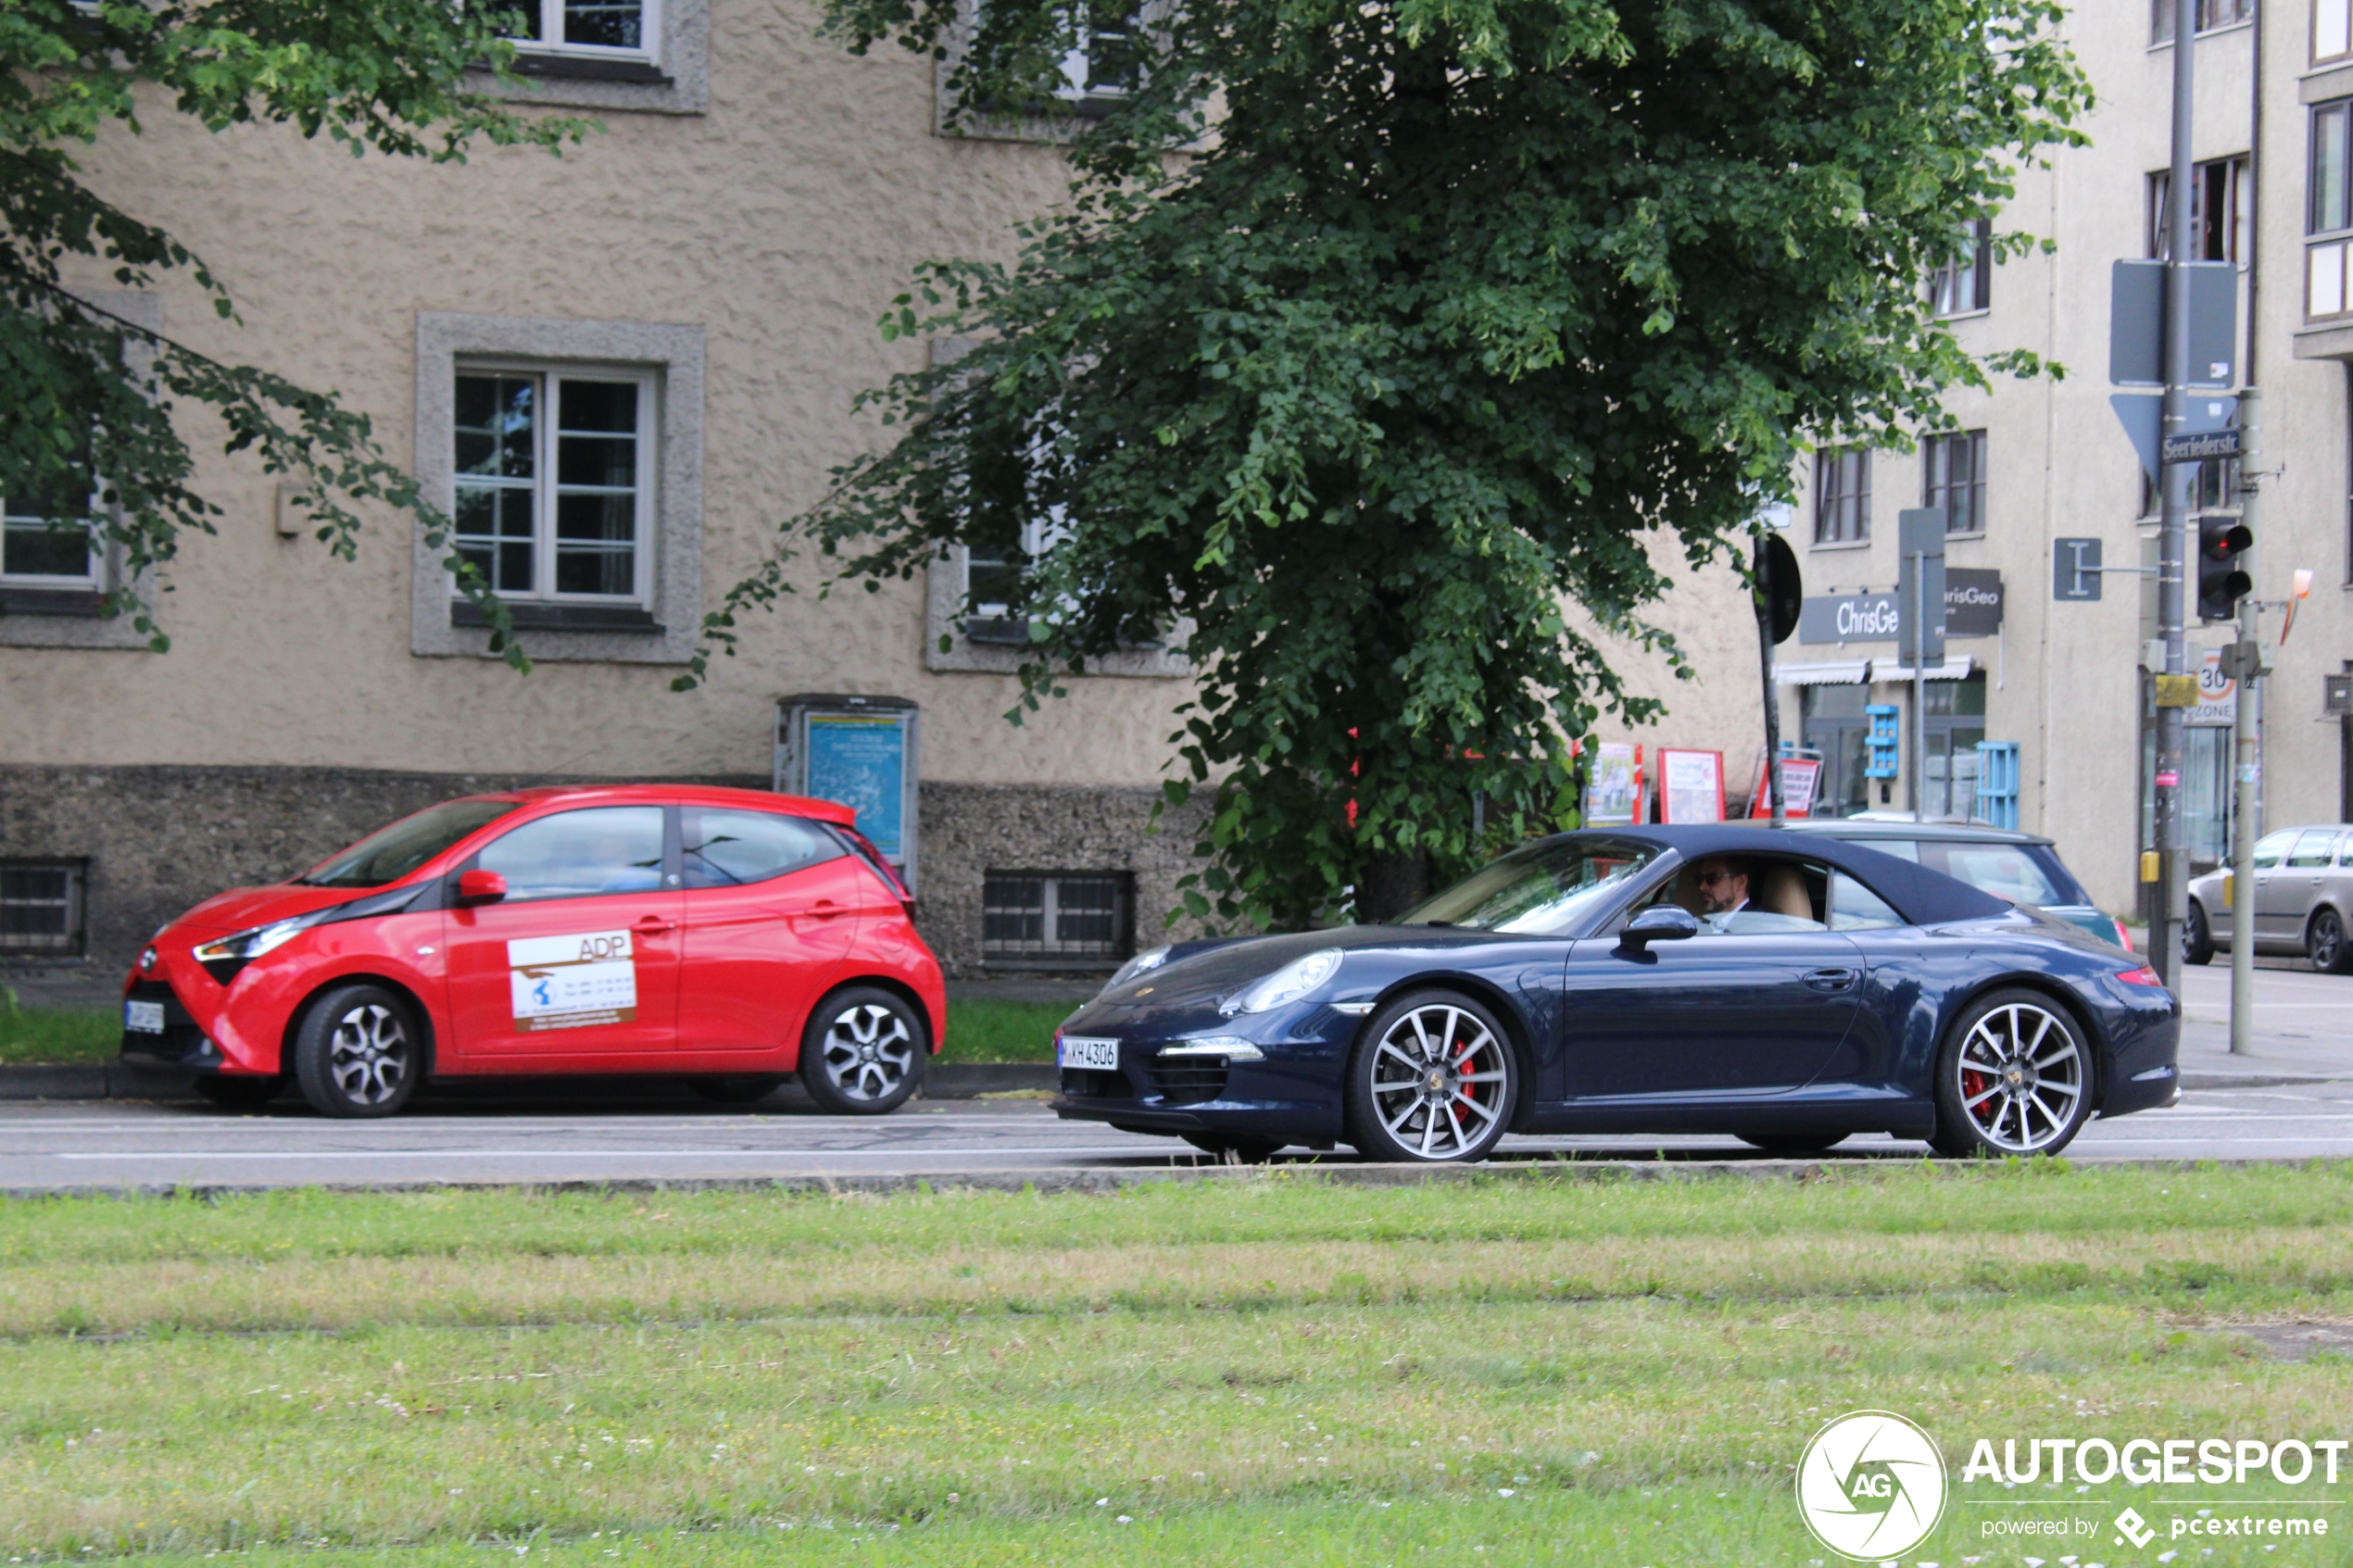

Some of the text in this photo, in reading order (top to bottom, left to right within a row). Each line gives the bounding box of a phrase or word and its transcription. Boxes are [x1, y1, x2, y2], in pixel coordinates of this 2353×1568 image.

[2201, 669, 2225, 688] 30
[2195, 705, 2233, 719] ZONE
[579, 935, 625, 960] ADP
